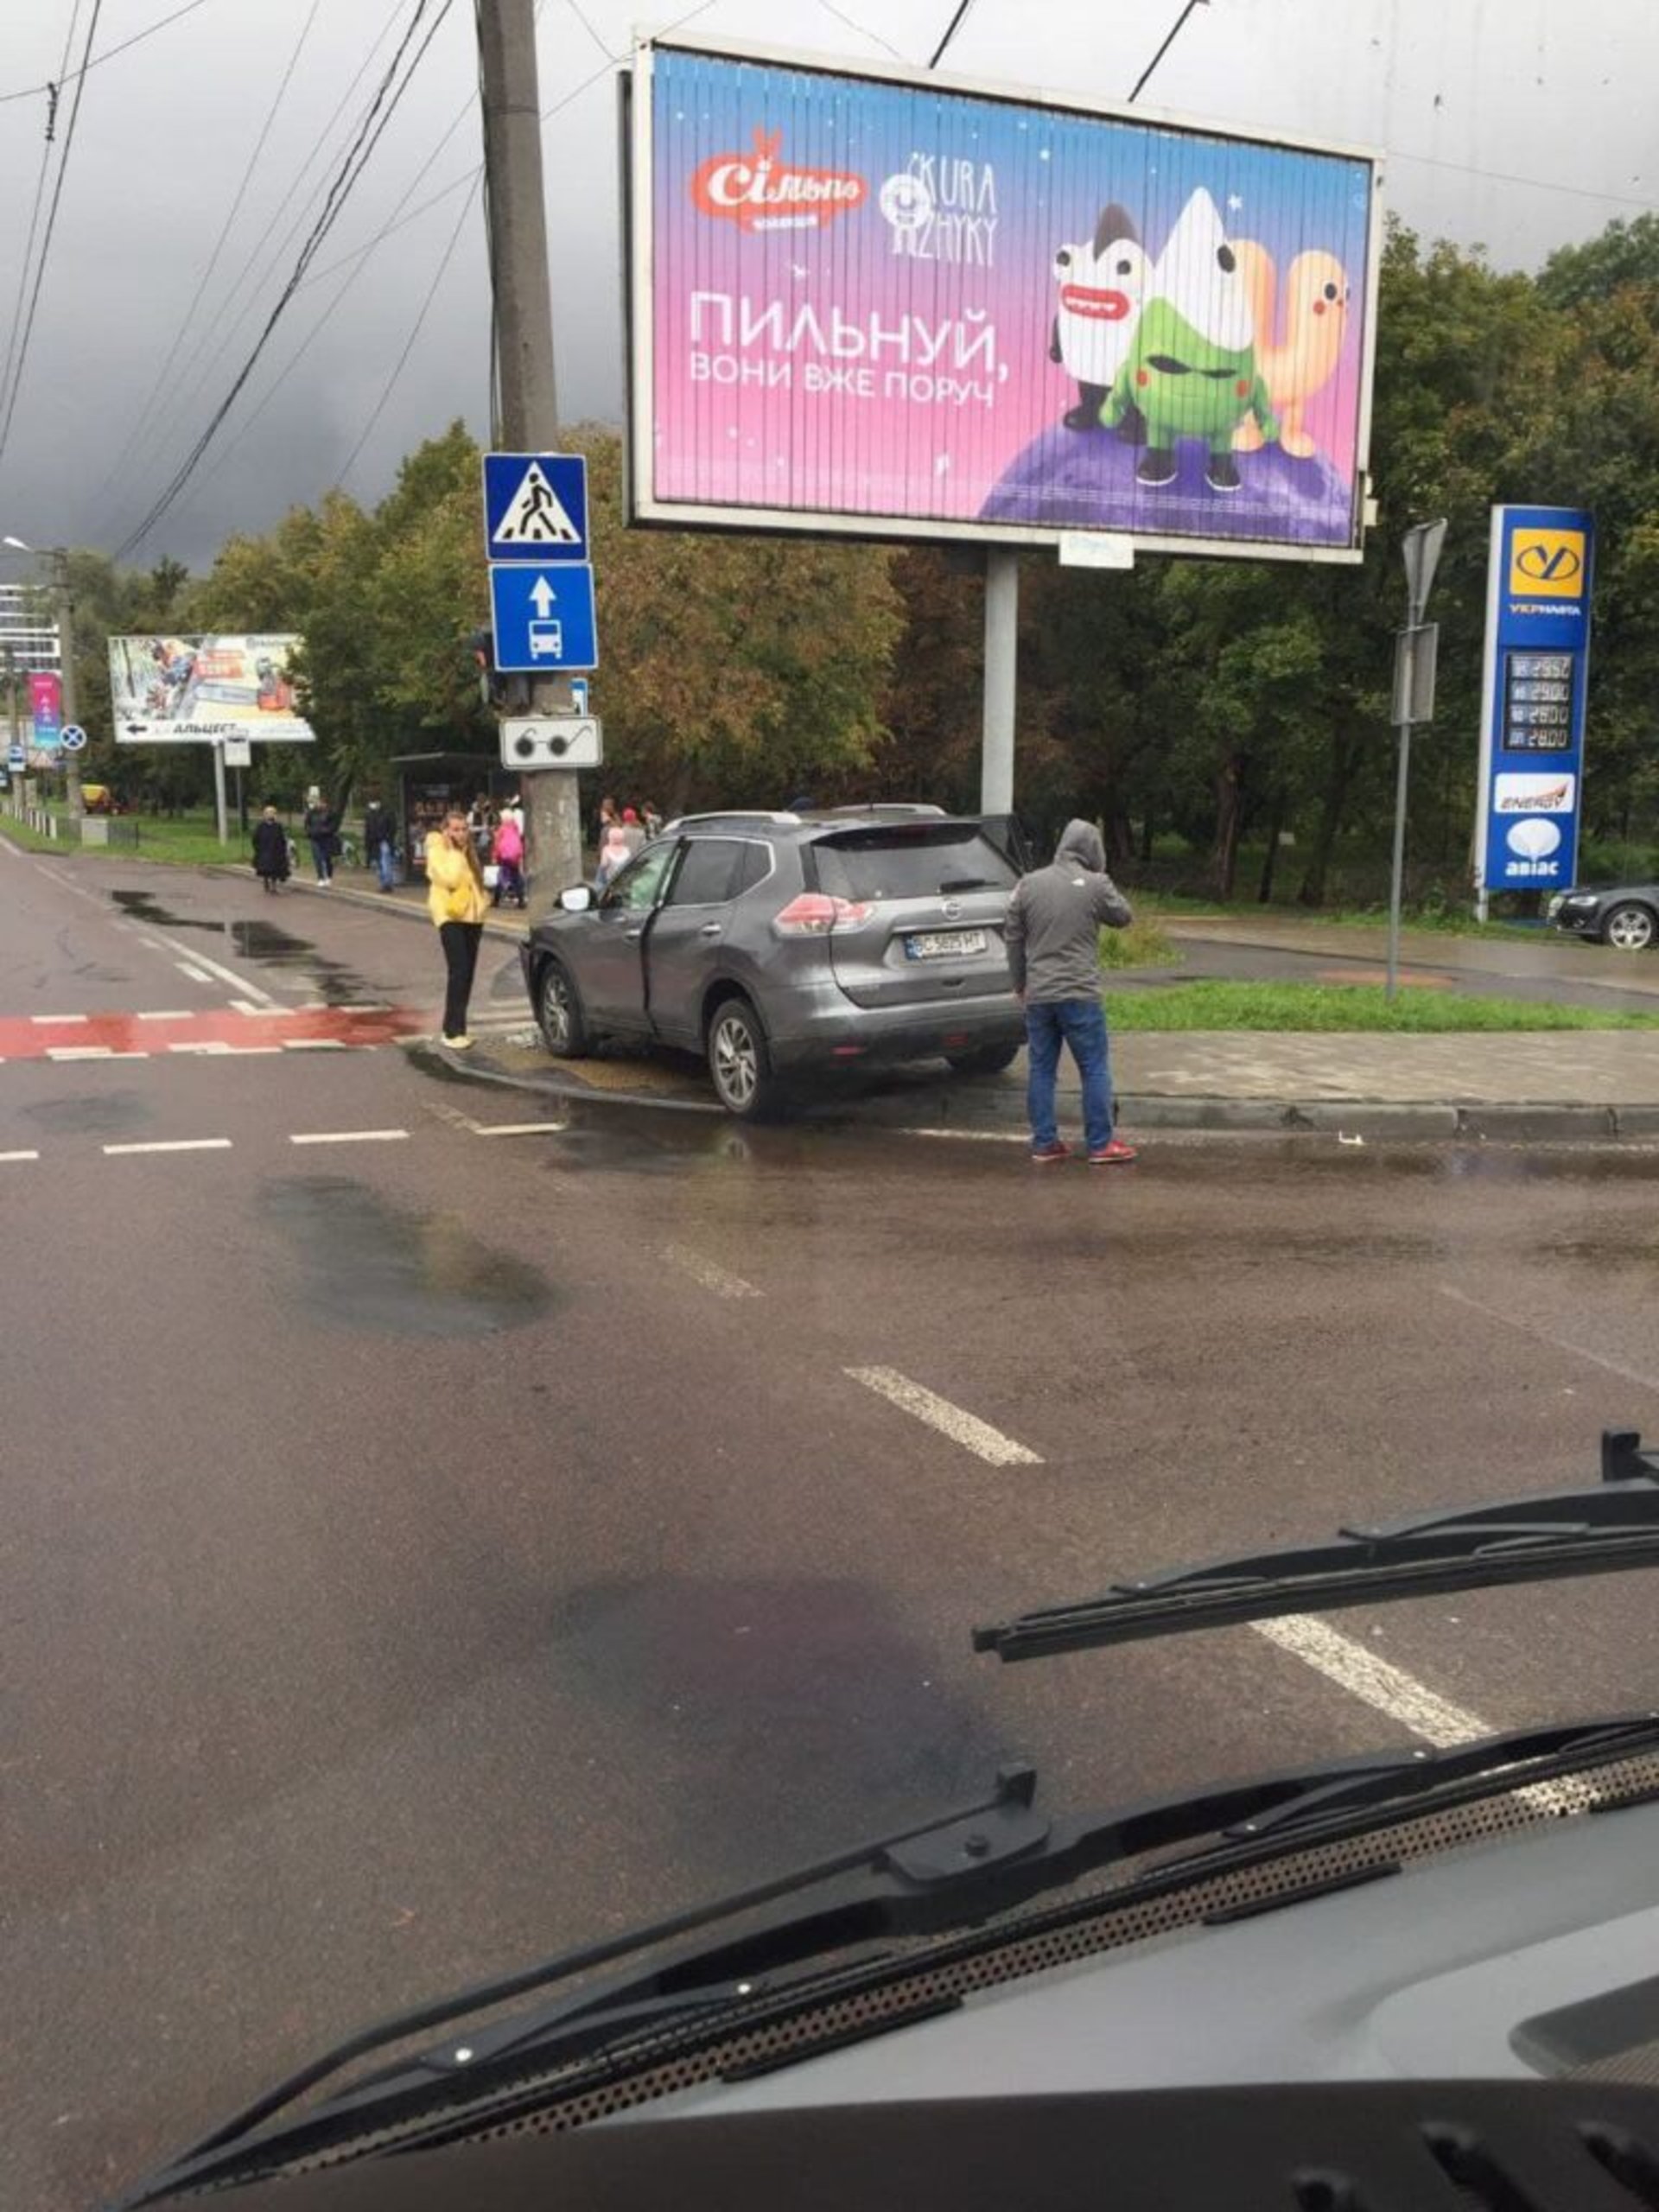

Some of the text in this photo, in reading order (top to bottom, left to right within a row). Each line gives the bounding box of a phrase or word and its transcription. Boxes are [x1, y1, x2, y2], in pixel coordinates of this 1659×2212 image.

[918, 152, 997, 214] KURA
[690, 290, 1008, 381] ПИЛЬНУЙ,
[690, 351, 995, 408] ВОНИ ВЖЕ ПОРУЧ
